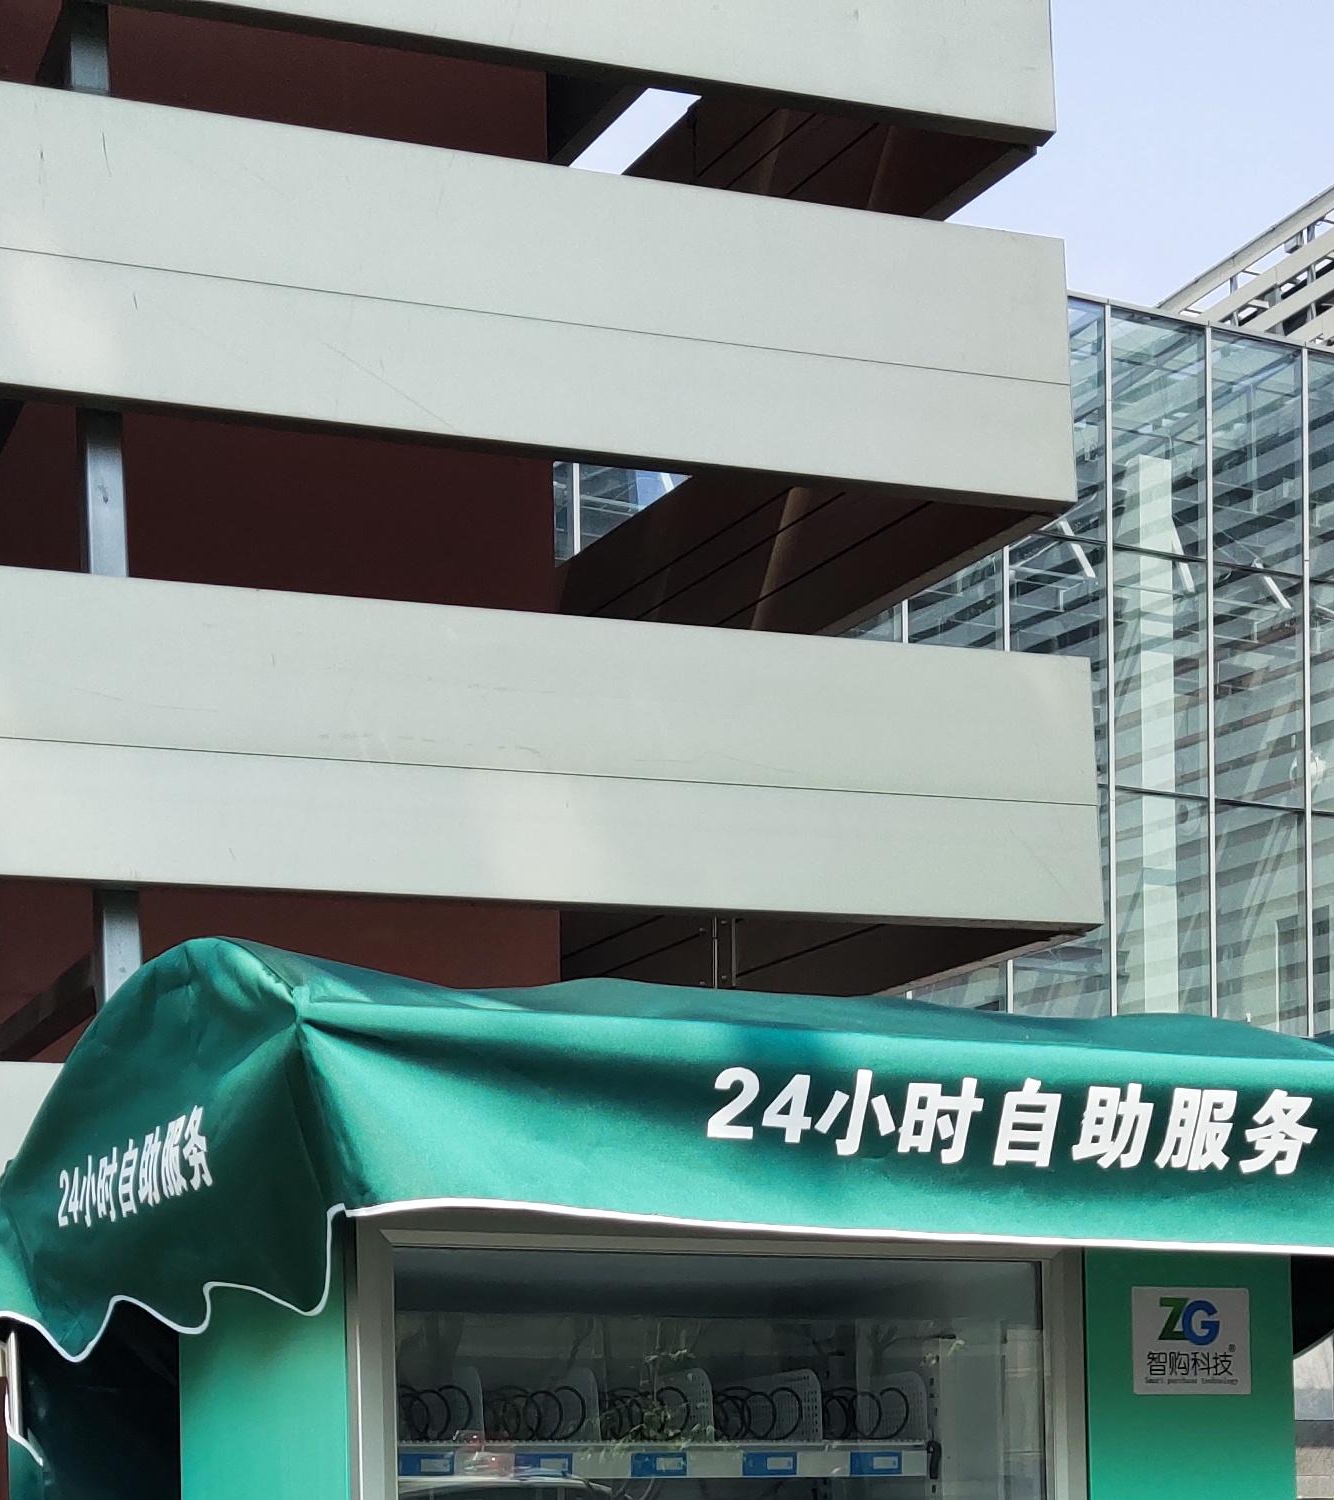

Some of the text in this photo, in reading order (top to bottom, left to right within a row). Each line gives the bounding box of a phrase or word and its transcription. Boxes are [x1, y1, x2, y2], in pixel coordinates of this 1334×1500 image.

[706, 1067, 1318, 1176] 24小时自助服务
[57, 1104, 216, 1228] 24小时自助服务
[1158, 1297, 1220, 1346] ZG
[1147, 1351, 1233, 1376] 智购科技
